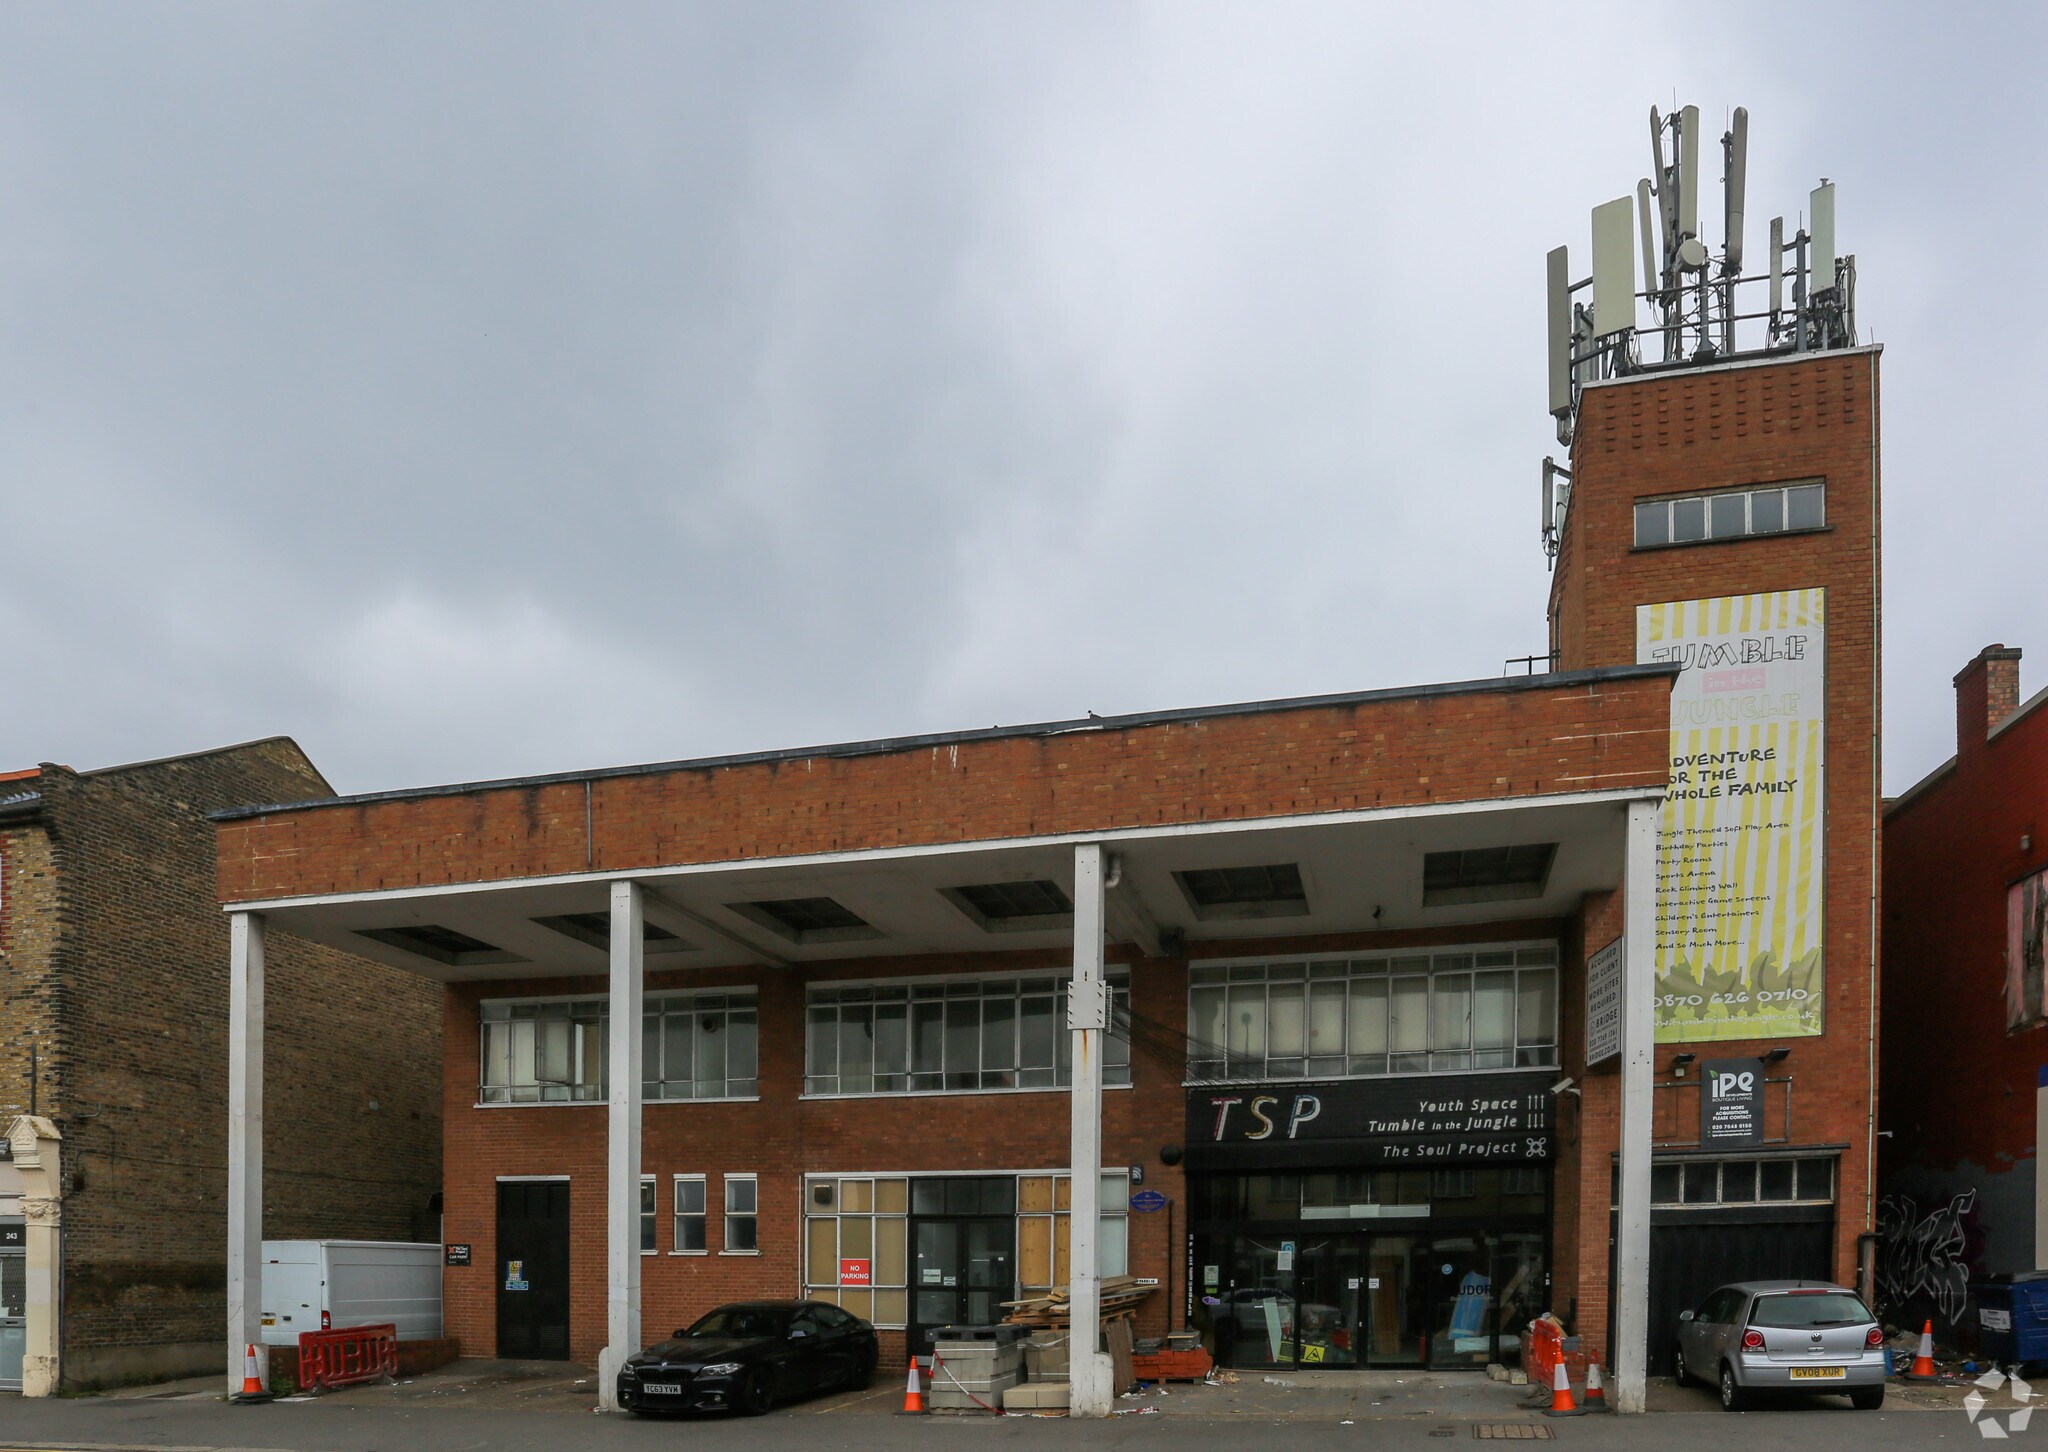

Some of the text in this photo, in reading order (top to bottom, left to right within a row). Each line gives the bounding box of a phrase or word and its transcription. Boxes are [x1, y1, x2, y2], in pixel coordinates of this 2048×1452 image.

[1652, 634, 1808, 671] TUMBLE
[1671, 693, 1801, 726] JUNGLE
[1670, 747, 1776, 768] DVENTURE
[1670, 767, 1738, 785] OR THE
[1728, 779, 1798, 796] FAMILY
[1656, 821, 1790, 840] Jungle Themed Soft Play Area
[1656, 840, 1728, 851] Birthday Parties
[1656, 855, 1713, 867] Party Rooms
[1656, 869, 1716, 880] Sports Arena
[1656, 881, 1738, 894] Rock Climbing Wall
[1656, 898, 1706, 908] Interactive
[1735, 894, 1771, 903] Screens
[1655, 908, 1760, 922] Children's Entertainers
[1655, 926, 1718, 937] Sensory Room
[1655, 941, 1674, 950] And
[1676, 941, 1687, 949] So
[1689, 939, 1713, 948] Much
[1591, 947, 1617, 970] ACQUIRED
[1600, 959, 1618, 976] CLIENT
[1604, 976, 1619, 992] SITES
[1653, 987, 1808, 1009] 0870 626 0710
[1596, 1008, 1618, 1028] BRIDGE
[1419, 1098, 1518, 1114] Youth Space
[1368, 1117, 1426, 1133] Tumble
[1445, 1120, 1461, 1130] the
[1465, 1115, 1518, 1131] Jungle
[1383, 1142, 1518, 1158] The Soul Project
[1795, 1367, 1840, 1377] GV08 XUR
